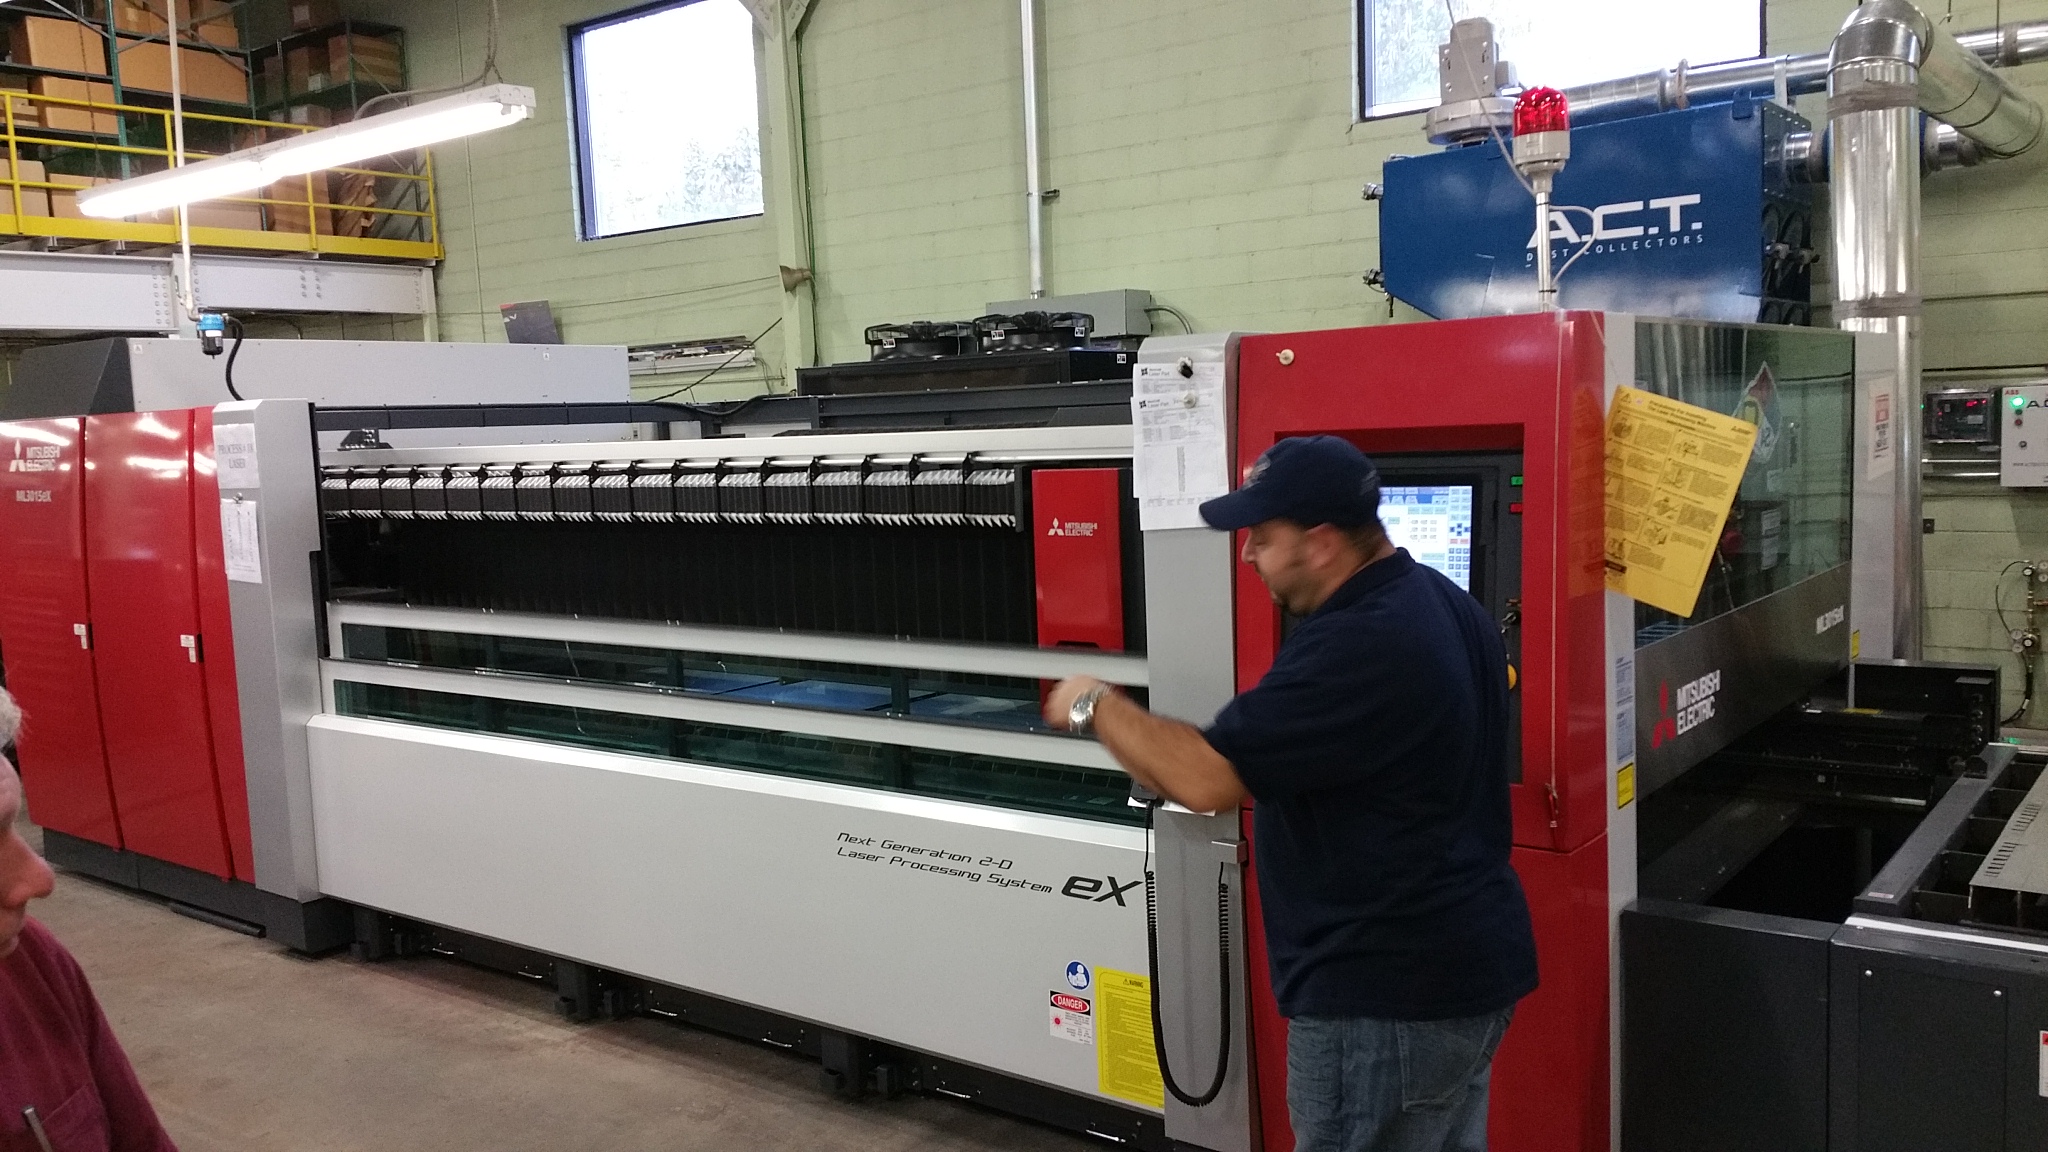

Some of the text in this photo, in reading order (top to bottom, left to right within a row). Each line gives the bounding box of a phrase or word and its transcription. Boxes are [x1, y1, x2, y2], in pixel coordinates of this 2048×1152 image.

[1526, 194, 1703, 249] A.C.T.
[1526, 249, 1569, 262] DST
[1064, 522, 1098, 530] MITSUBISHI
[1064, 529, 1094, 537] ELECTRIC
[1676, 669, 1721, 711] MITSUBISHI
[1676, 695, 1716, 736] ELECTRIC
[837, 832, 1013, 870] Next Generation 2-D
[837, 847, 1053, 893] Laser Processing System
[1057, 996, 1083, 1011] DANGER
